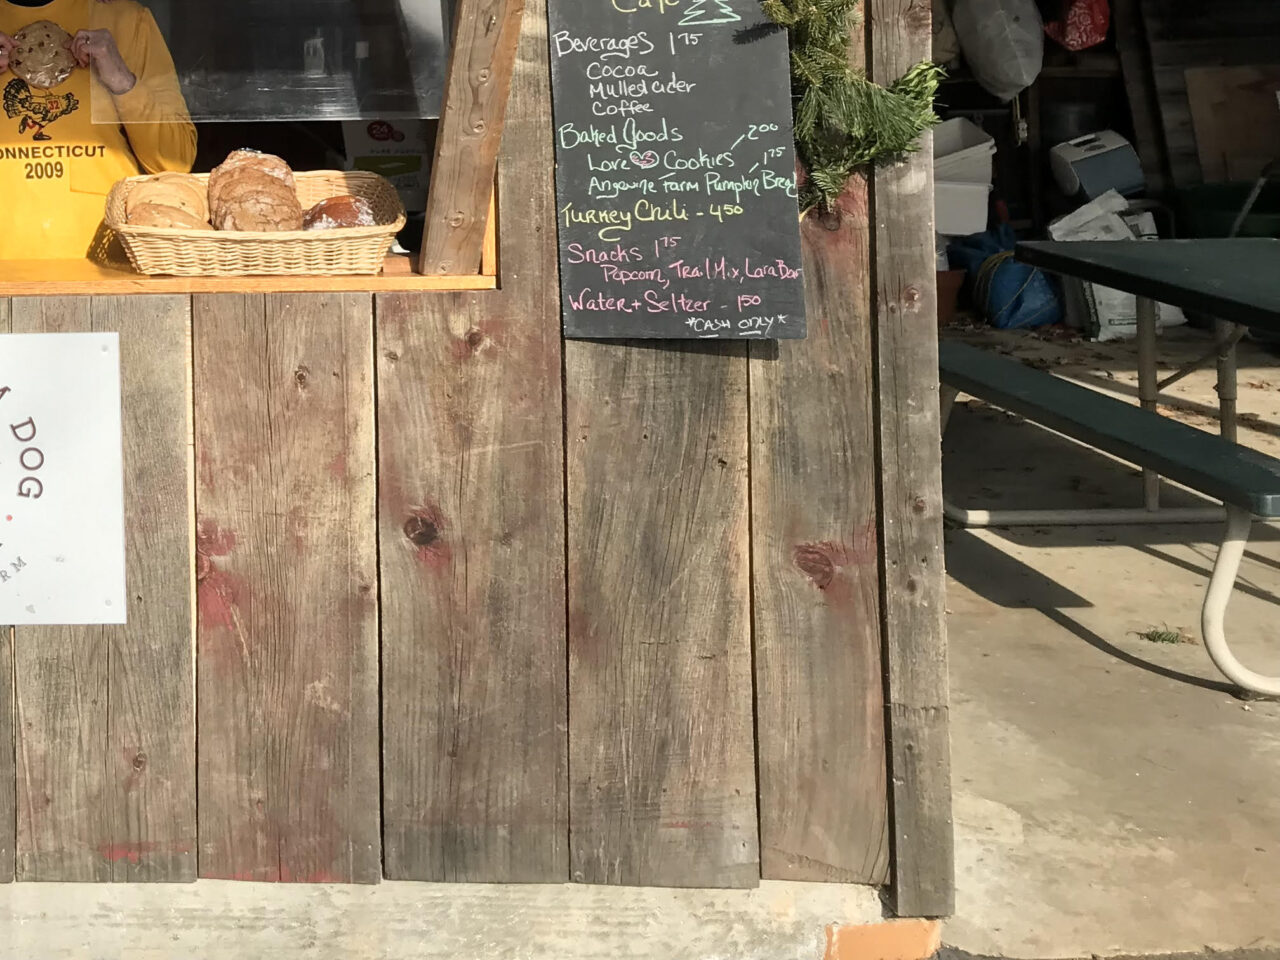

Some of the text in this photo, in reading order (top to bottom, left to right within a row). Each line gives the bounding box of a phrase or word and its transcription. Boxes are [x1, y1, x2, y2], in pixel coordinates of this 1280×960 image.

[552, 30, 655, 61] Beverages
[586, 62, 659, 80] Cocoa
[48, 99, 60, 110] 32
[592, 100, 654, 117] Coffee
[558, 122, 618, 149] Baked
[24, 161, 64, 180] 2009
[587, 153, 631, 172] Love
[663, 147, 735, 171] Cookies
[703, 171, 761, 204] Pumpkin
[634, 198, 689, 221] Chili
[567, 242, 644, 264] Snacks
[643, 289, 712, 313] Seltzer
[10, 416, 45, 500] DOG
